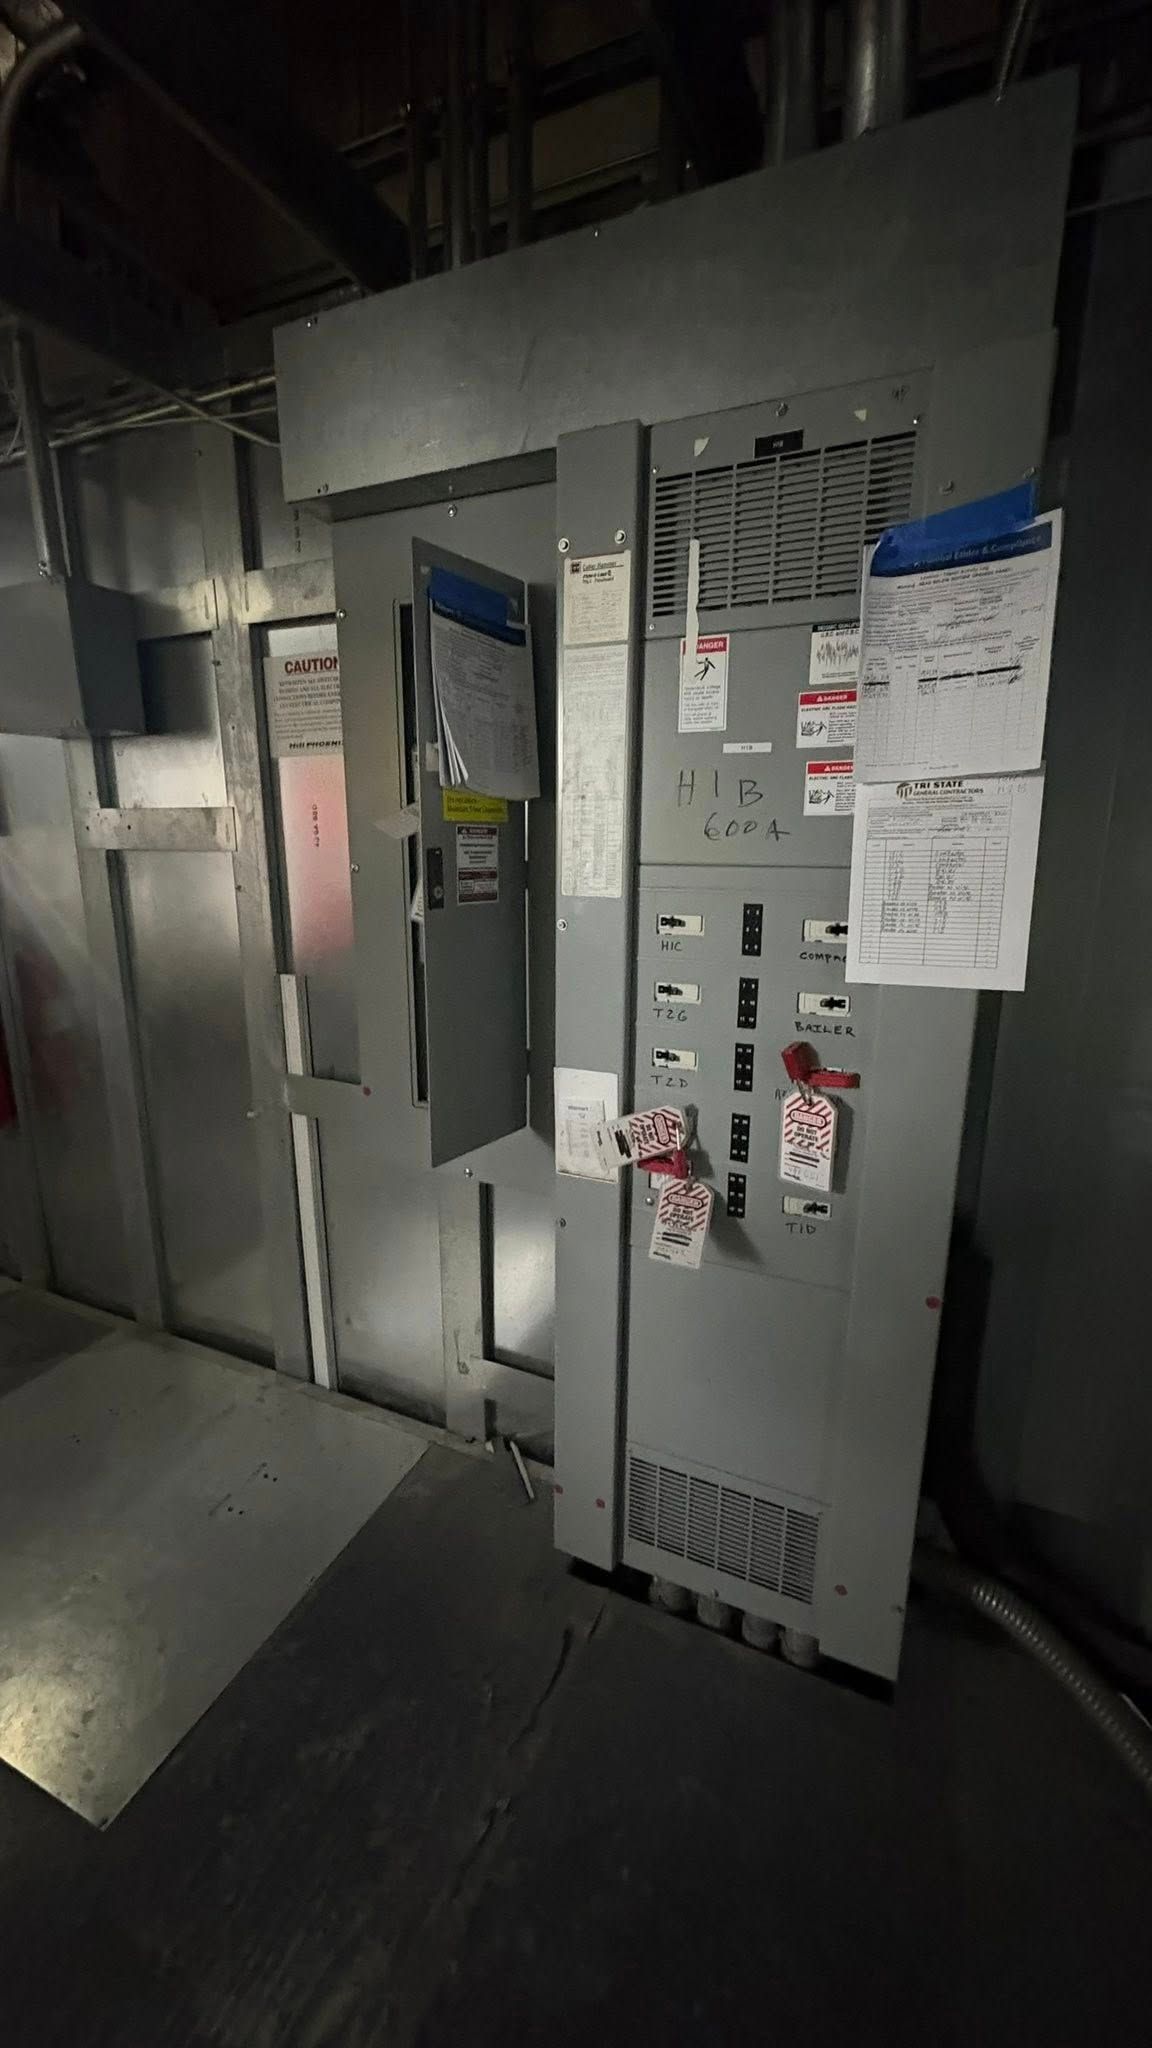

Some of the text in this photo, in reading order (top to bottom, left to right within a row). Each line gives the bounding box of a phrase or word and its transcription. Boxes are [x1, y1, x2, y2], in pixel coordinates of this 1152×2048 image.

[990, 535, 1043, 554] Compliance
[697, 640, 724, 650] ANGER
[306, 740, 342, 748] PHOENI
[933, 780, 963, 788] STATE
[913, 787, 984, 796] GENERAL CONTRACTORS
[794, 1021, 856, 1037] BAILER
[796, 1125, 818, 1137] DO NOT
[793, 1131, 819, 1143] OPERATE
[669, 1212, 695, 1223] OPERATE
